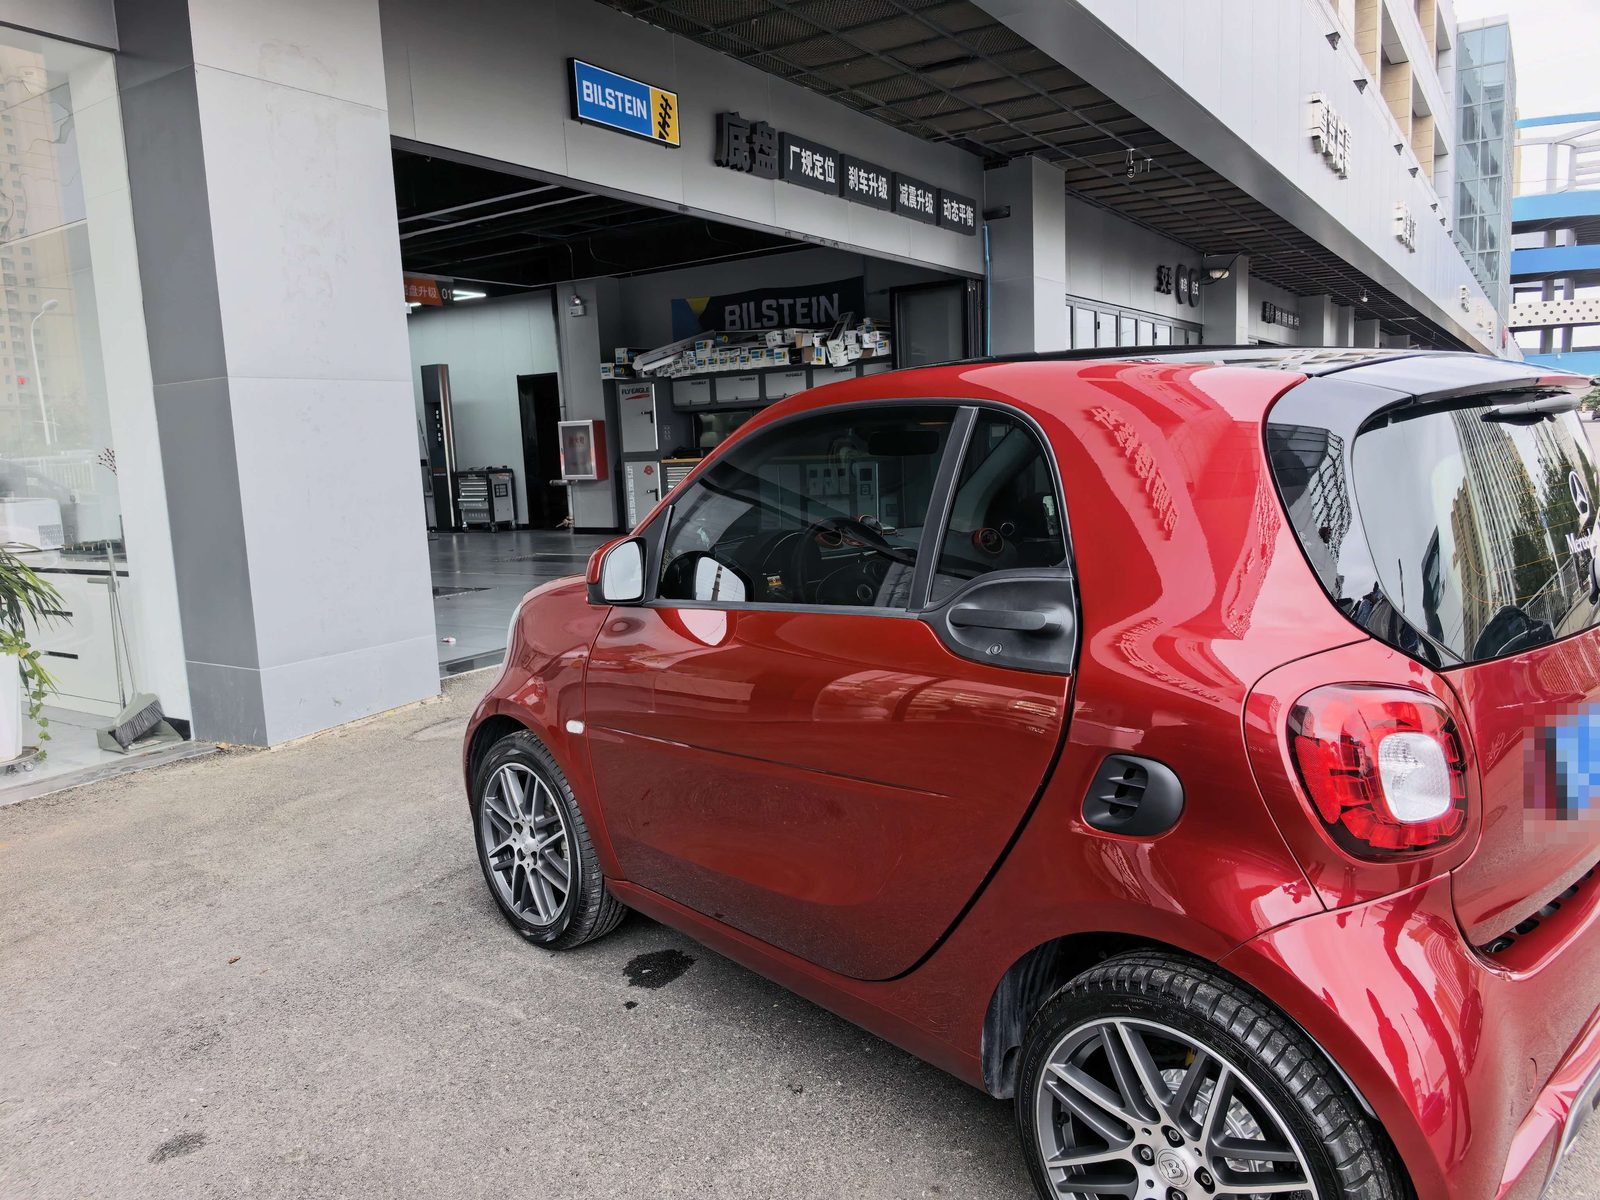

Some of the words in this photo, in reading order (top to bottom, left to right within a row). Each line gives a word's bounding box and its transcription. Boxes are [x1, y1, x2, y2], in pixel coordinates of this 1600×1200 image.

[582, 80, 648, 120] BILSTEIN
[715, 112, 779, 179] 底盘
[789, 145, 836, 183] 厂规定位
[848, 166, 888, 200] 刹车升级
[899, 183, 934, 214] 减震升级
[943, 198, 974, 227] 动态平衡
[441, 288, 452, 300] 01
[725, 292, 840, 331] BILSTEIN
